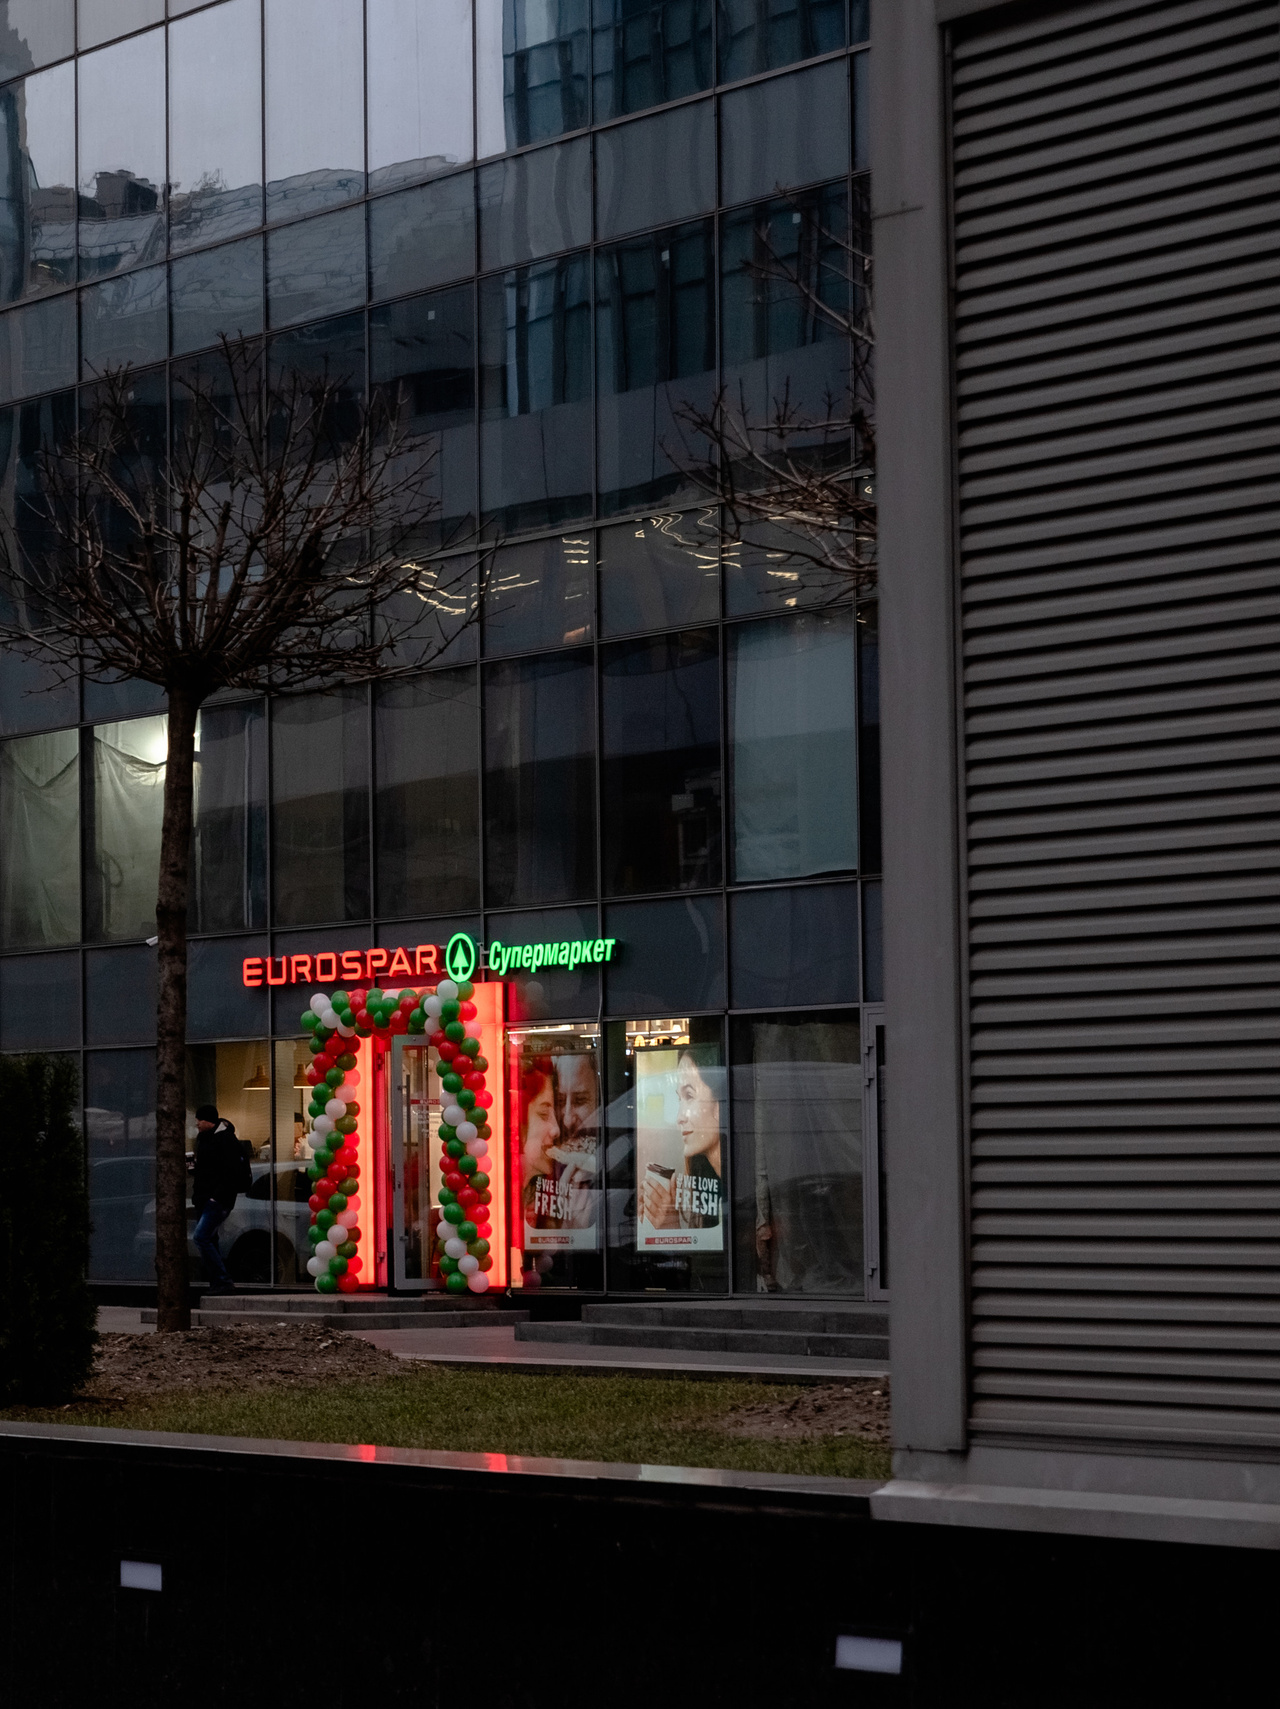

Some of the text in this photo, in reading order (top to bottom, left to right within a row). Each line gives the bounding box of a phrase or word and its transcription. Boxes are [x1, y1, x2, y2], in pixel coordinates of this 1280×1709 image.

[242, 944, 438, 987] EUROSPAR
[489, 938, 616, 976] Супермаркет
[535, 1176, 573, 1198] #WE LOVE
[676, 1173, 719, 1193] #WE LOVE
[534, 1191, 571, 1221] FRESH
[675, 1187, 718, 1217] FRESH
